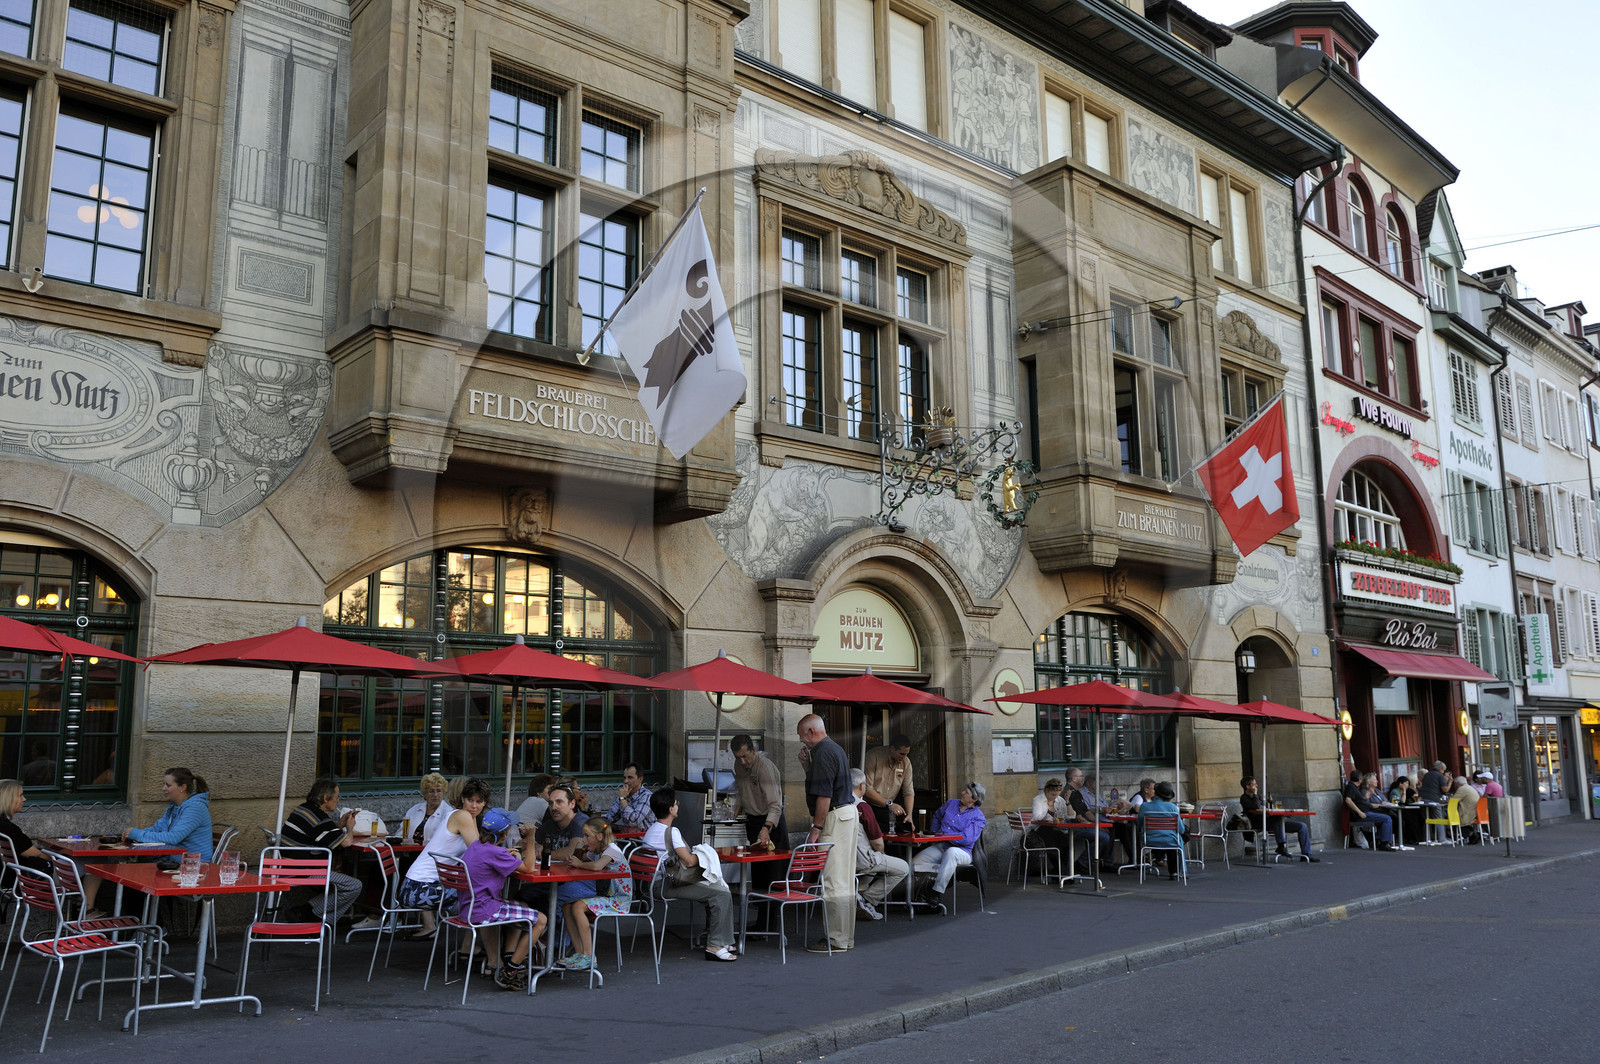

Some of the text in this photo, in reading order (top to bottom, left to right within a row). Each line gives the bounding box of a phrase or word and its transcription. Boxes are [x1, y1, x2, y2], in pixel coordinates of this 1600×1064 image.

[50, 369, 120, 420] Mutz
[536, 384, 607, 410] BRAUEREI
[1380, 407, 1413, 437] Fourny
[1450, 431, 1493, 471] Apotheke
[1118, 510, 1203, 541] ZUM BRAUNEN MUTZ
[1144, 504, 1177, 519] BIERHALLE
[1351, 571, 1452, 606] ZIEGELHOF BIER
[839, 614, 883, 629] BRAUNEN
[1383, 618, 1438, 649] Rio Bar
[839, 630, 884, 653] MUTZ
[1529, 616, 1544, 666] Apotheke
